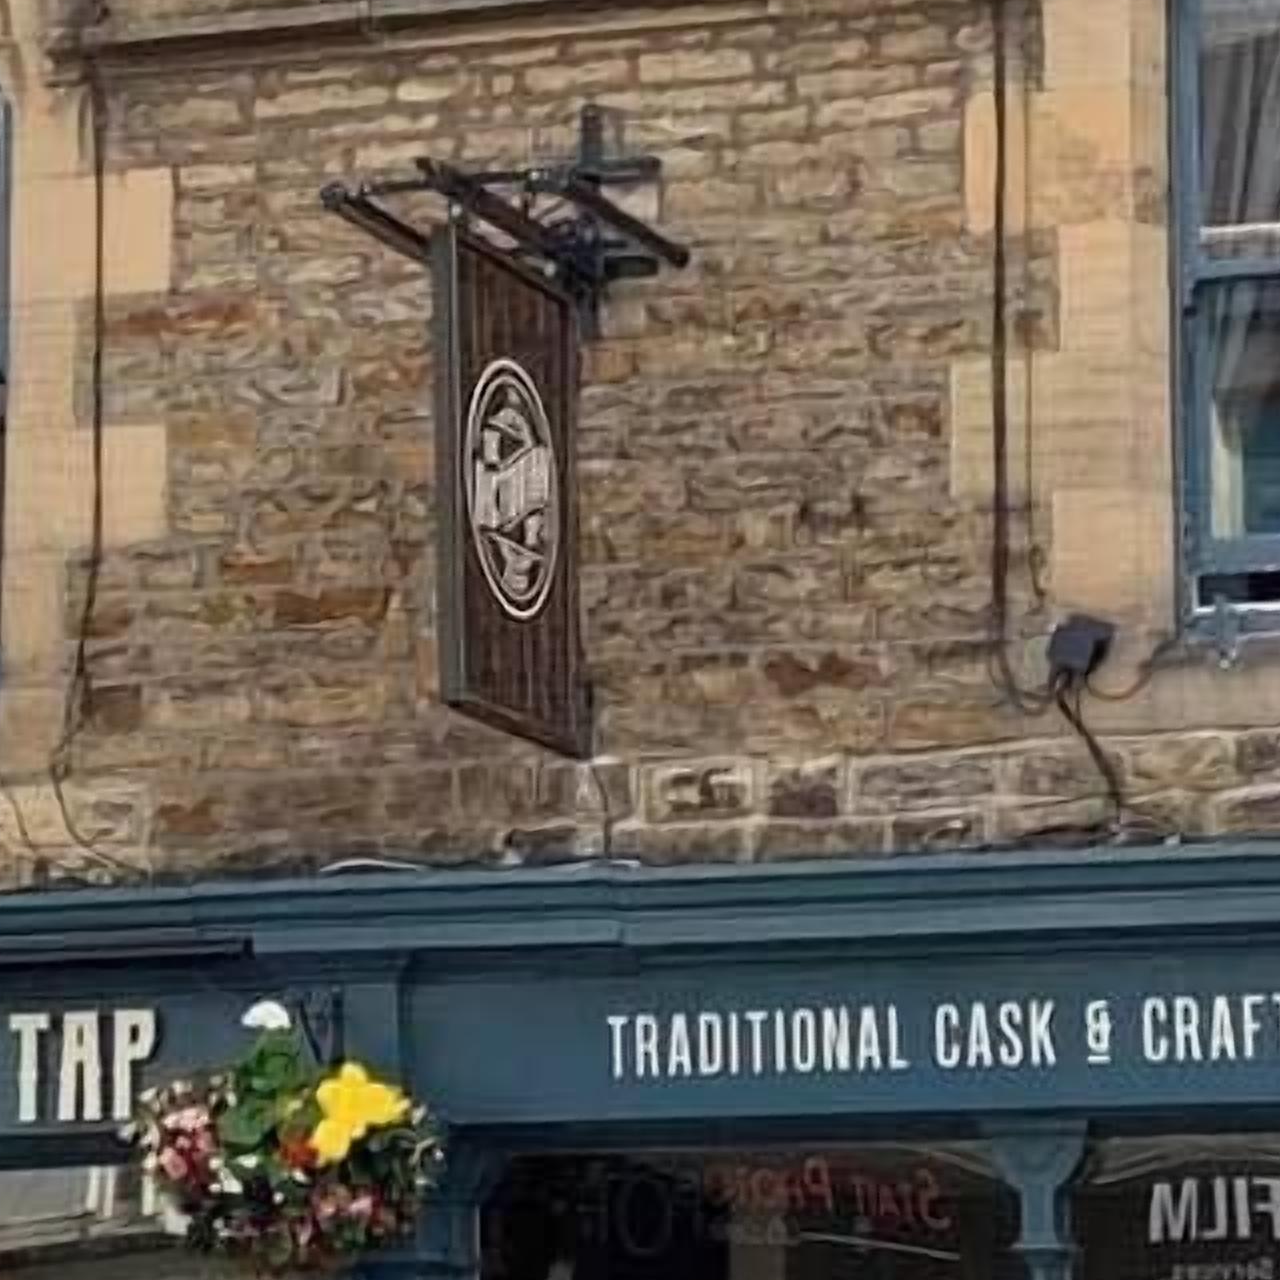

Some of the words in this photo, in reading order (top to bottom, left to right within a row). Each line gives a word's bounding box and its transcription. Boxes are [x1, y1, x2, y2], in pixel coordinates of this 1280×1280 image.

[8, 1008, 158, 1124] TAP
[606, 1004, 910, 1078] TRADITIONAL
[934, 998, 1058, 1068] CASK
[1085, 999, 1114, 1062] &
